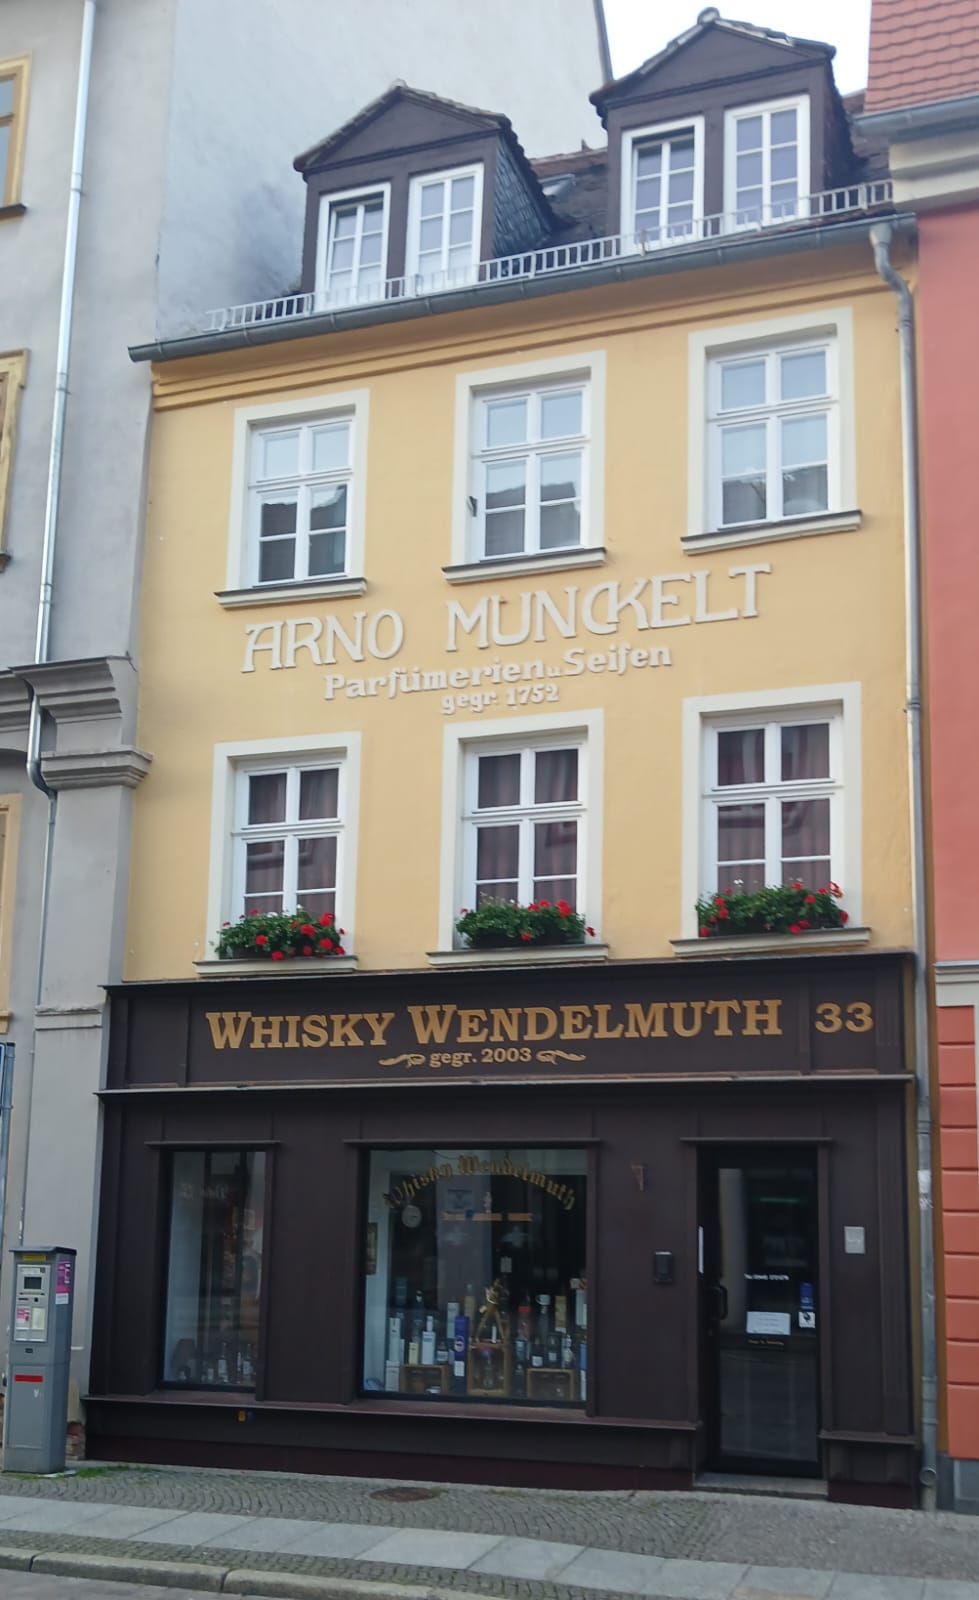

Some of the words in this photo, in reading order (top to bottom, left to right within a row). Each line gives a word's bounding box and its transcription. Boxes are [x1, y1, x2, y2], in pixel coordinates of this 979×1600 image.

[240, 608, 405, 673] ARNO
[446, 563, 772, 653] MUNCKELT
[324, 657, 545, 701] Parfümerien
[563, 643, 672, 677] Seifen
[506, 683, 560, 710] 1752
[205, 1011, 396, 1049] WHISKY
[407, 999, 783, 1044] WENDELMUTH
[814, 1002, 874, 1034] 33
[429, 1051, 477, 1068] gegr.
[480, 1047, 532, 1064] 2003
